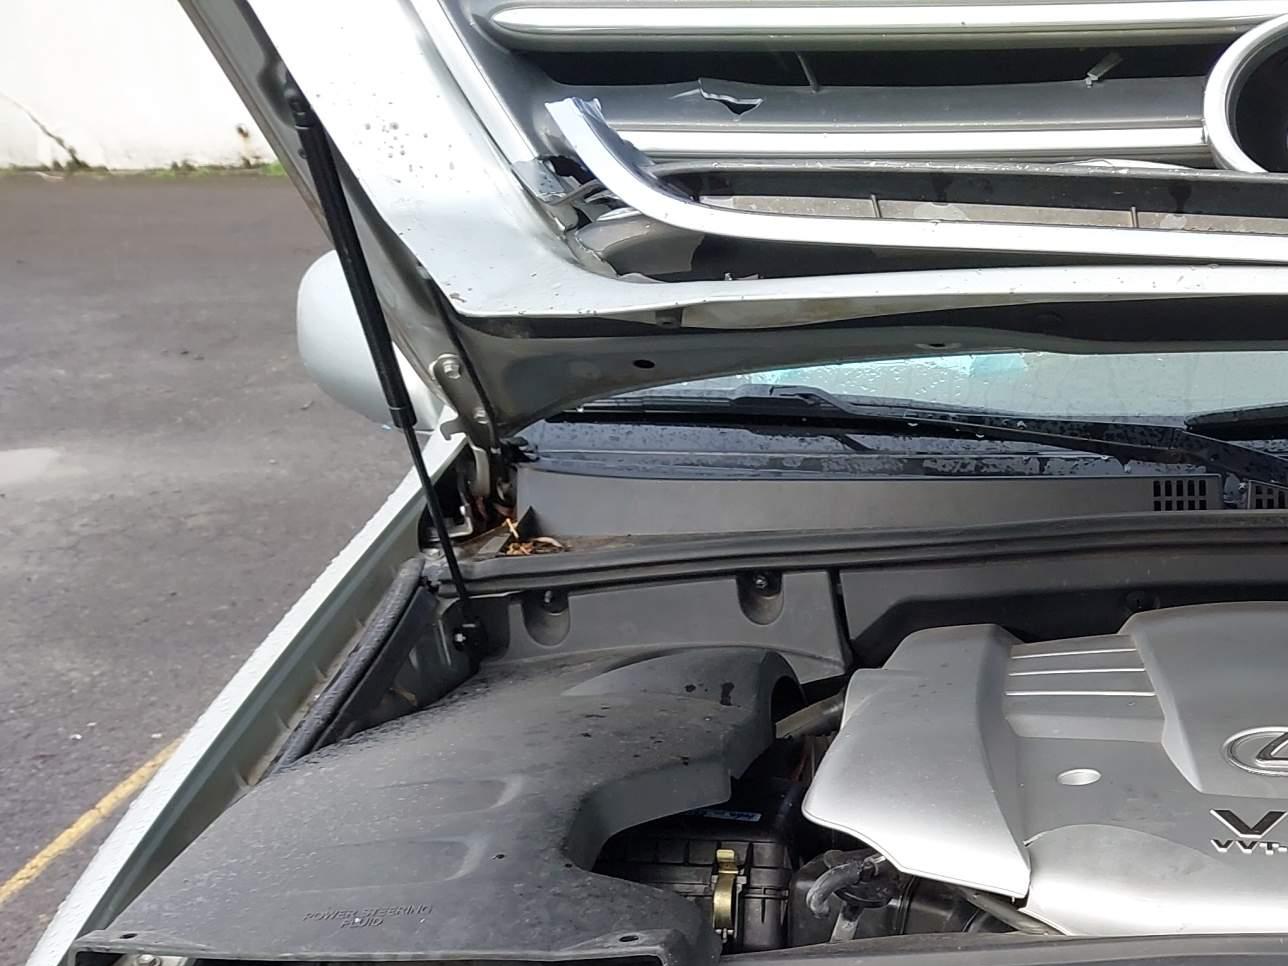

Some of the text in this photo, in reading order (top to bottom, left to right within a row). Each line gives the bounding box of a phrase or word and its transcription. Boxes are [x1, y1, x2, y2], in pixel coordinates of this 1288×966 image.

[303, 904, 433, 921] POWER STEERING
[340, 918, 385, 928] FLUID
